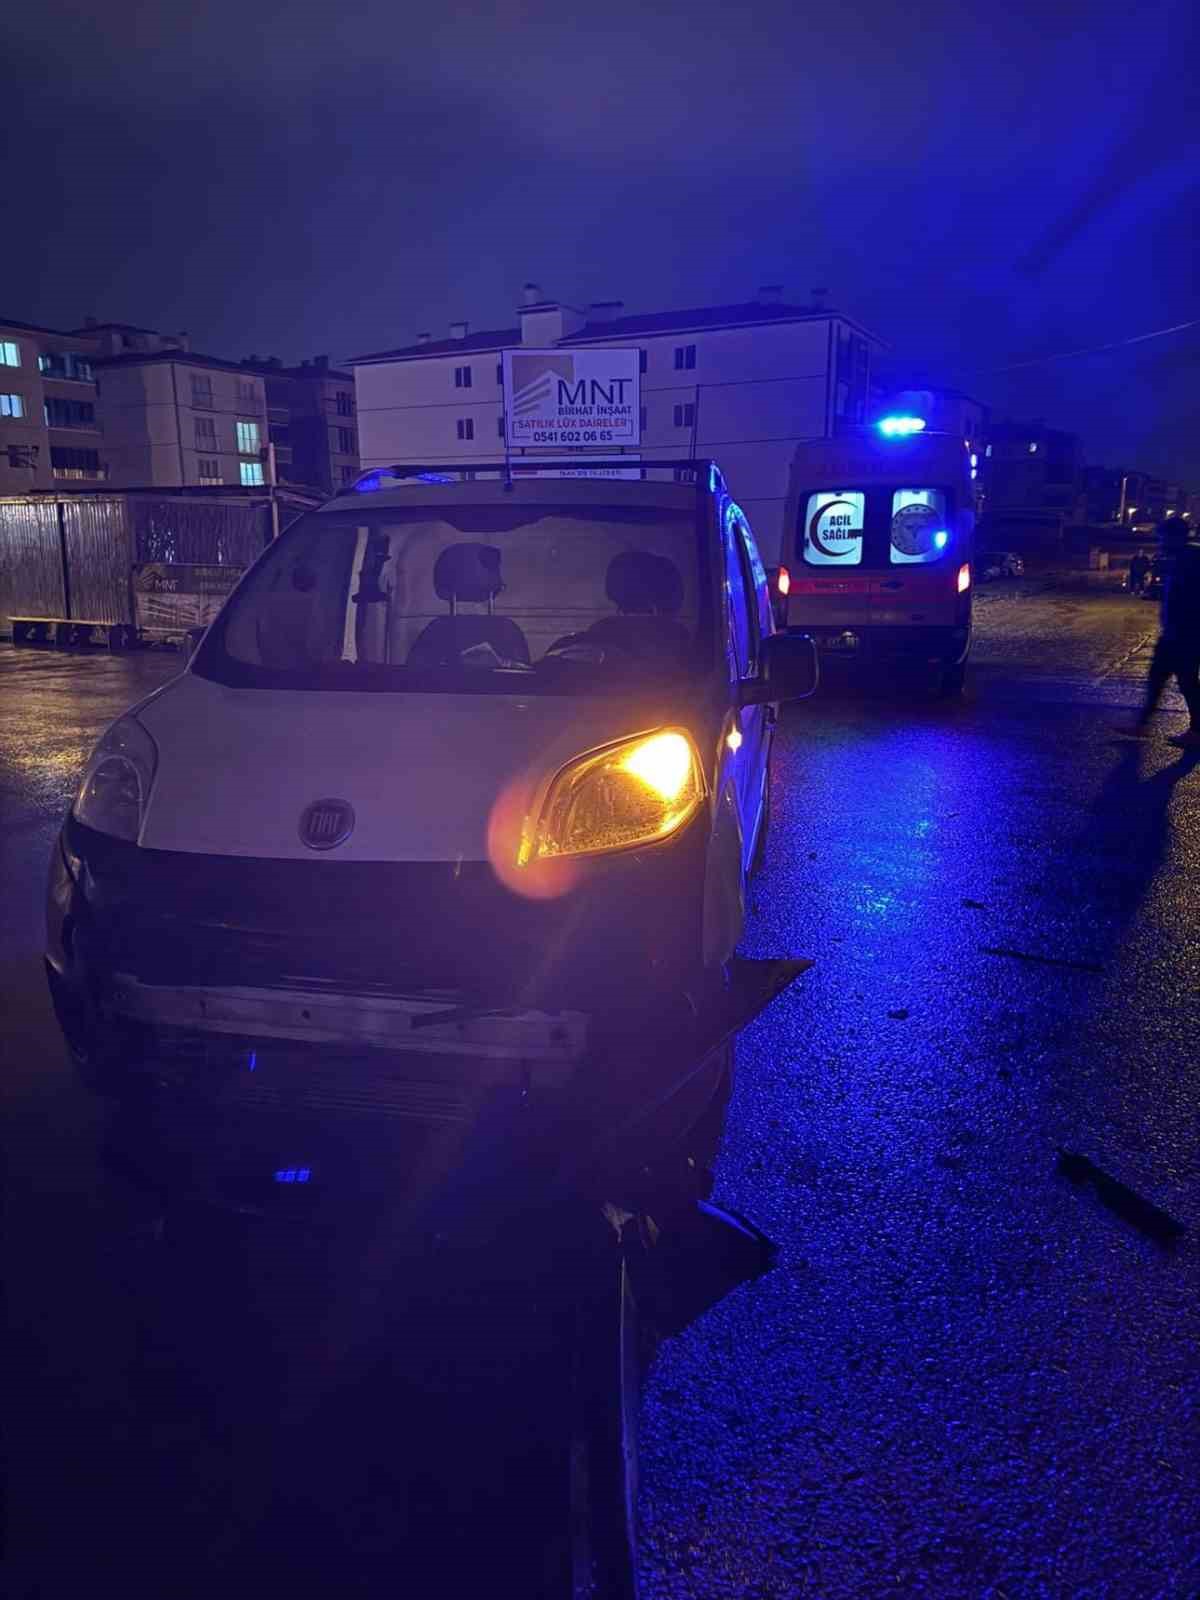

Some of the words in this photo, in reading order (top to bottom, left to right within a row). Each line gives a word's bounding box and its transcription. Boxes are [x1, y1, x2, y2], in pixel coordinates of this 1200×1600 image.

[558, 379, 632, 405] MNT
[597, 405, 632, 416] İNŞAAT
[518, 419, 557, 429] SATILIK
[534, 431, 558, 442] 0541
[560, 431, 580, 442] 602
[583, 431, 597, 441] 06
[600, 430, 613, 441] 65
[830, 513, 852, 526] ACİL
